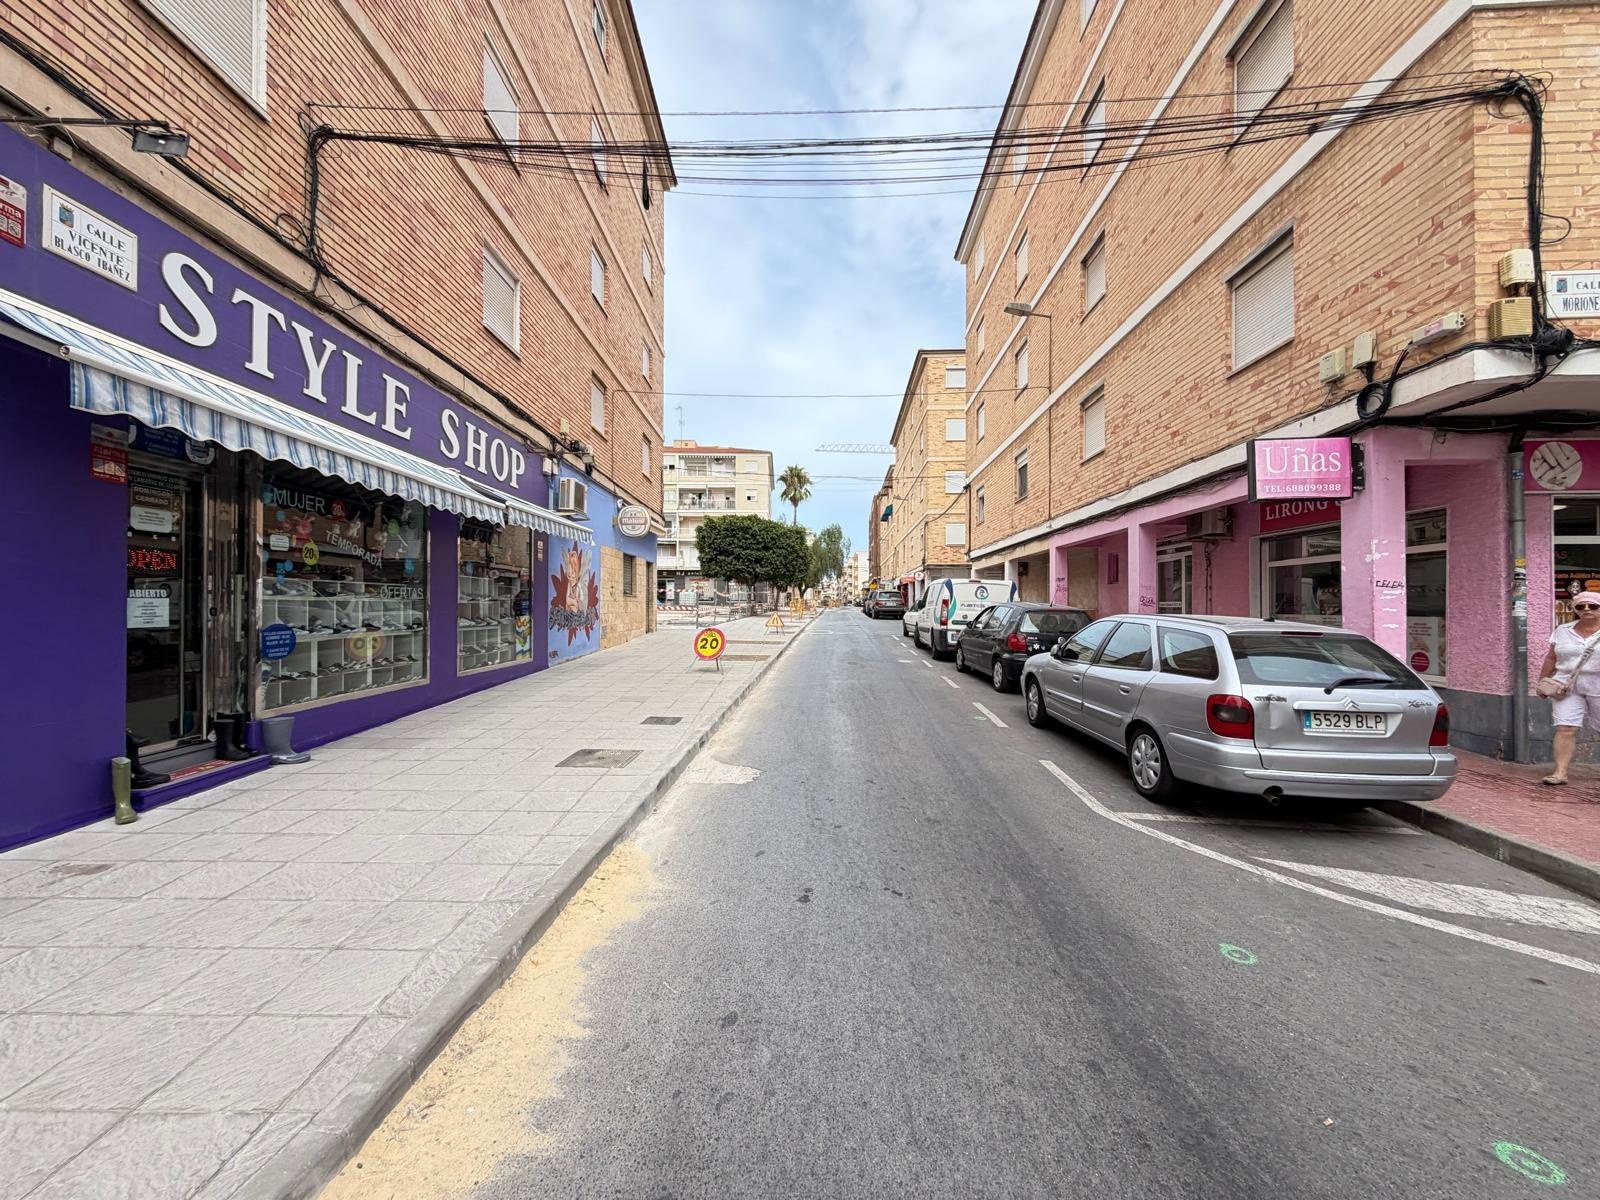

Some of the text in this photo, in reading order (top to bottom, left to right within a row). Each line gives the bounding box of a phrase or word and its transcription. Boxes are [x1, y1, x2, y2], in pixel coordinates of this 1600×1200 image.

[54, 235, 91, 263] BLASCO
[68, 230, 124, 268] VICENTE
[86, 223, 127, 253] CALLE
[159, 252, 526, 489] STYLE SHOP
[1263, 446, 1342, 474] Uñas
[273, 487, 326, 514] MUJER
[1263, 483, 1342, 493] TEL:688099388
[1265, 500, 1328, 521] LIRONG
[325, 529, 383, 569] TEMPORADA
[129, 589, 168, 598] ABIERTO
[379, 586, 424, 600] OFERTAS
[700, 638, 719, 649] 20
[1313, 714, 1382, 729] 5529 BLP
